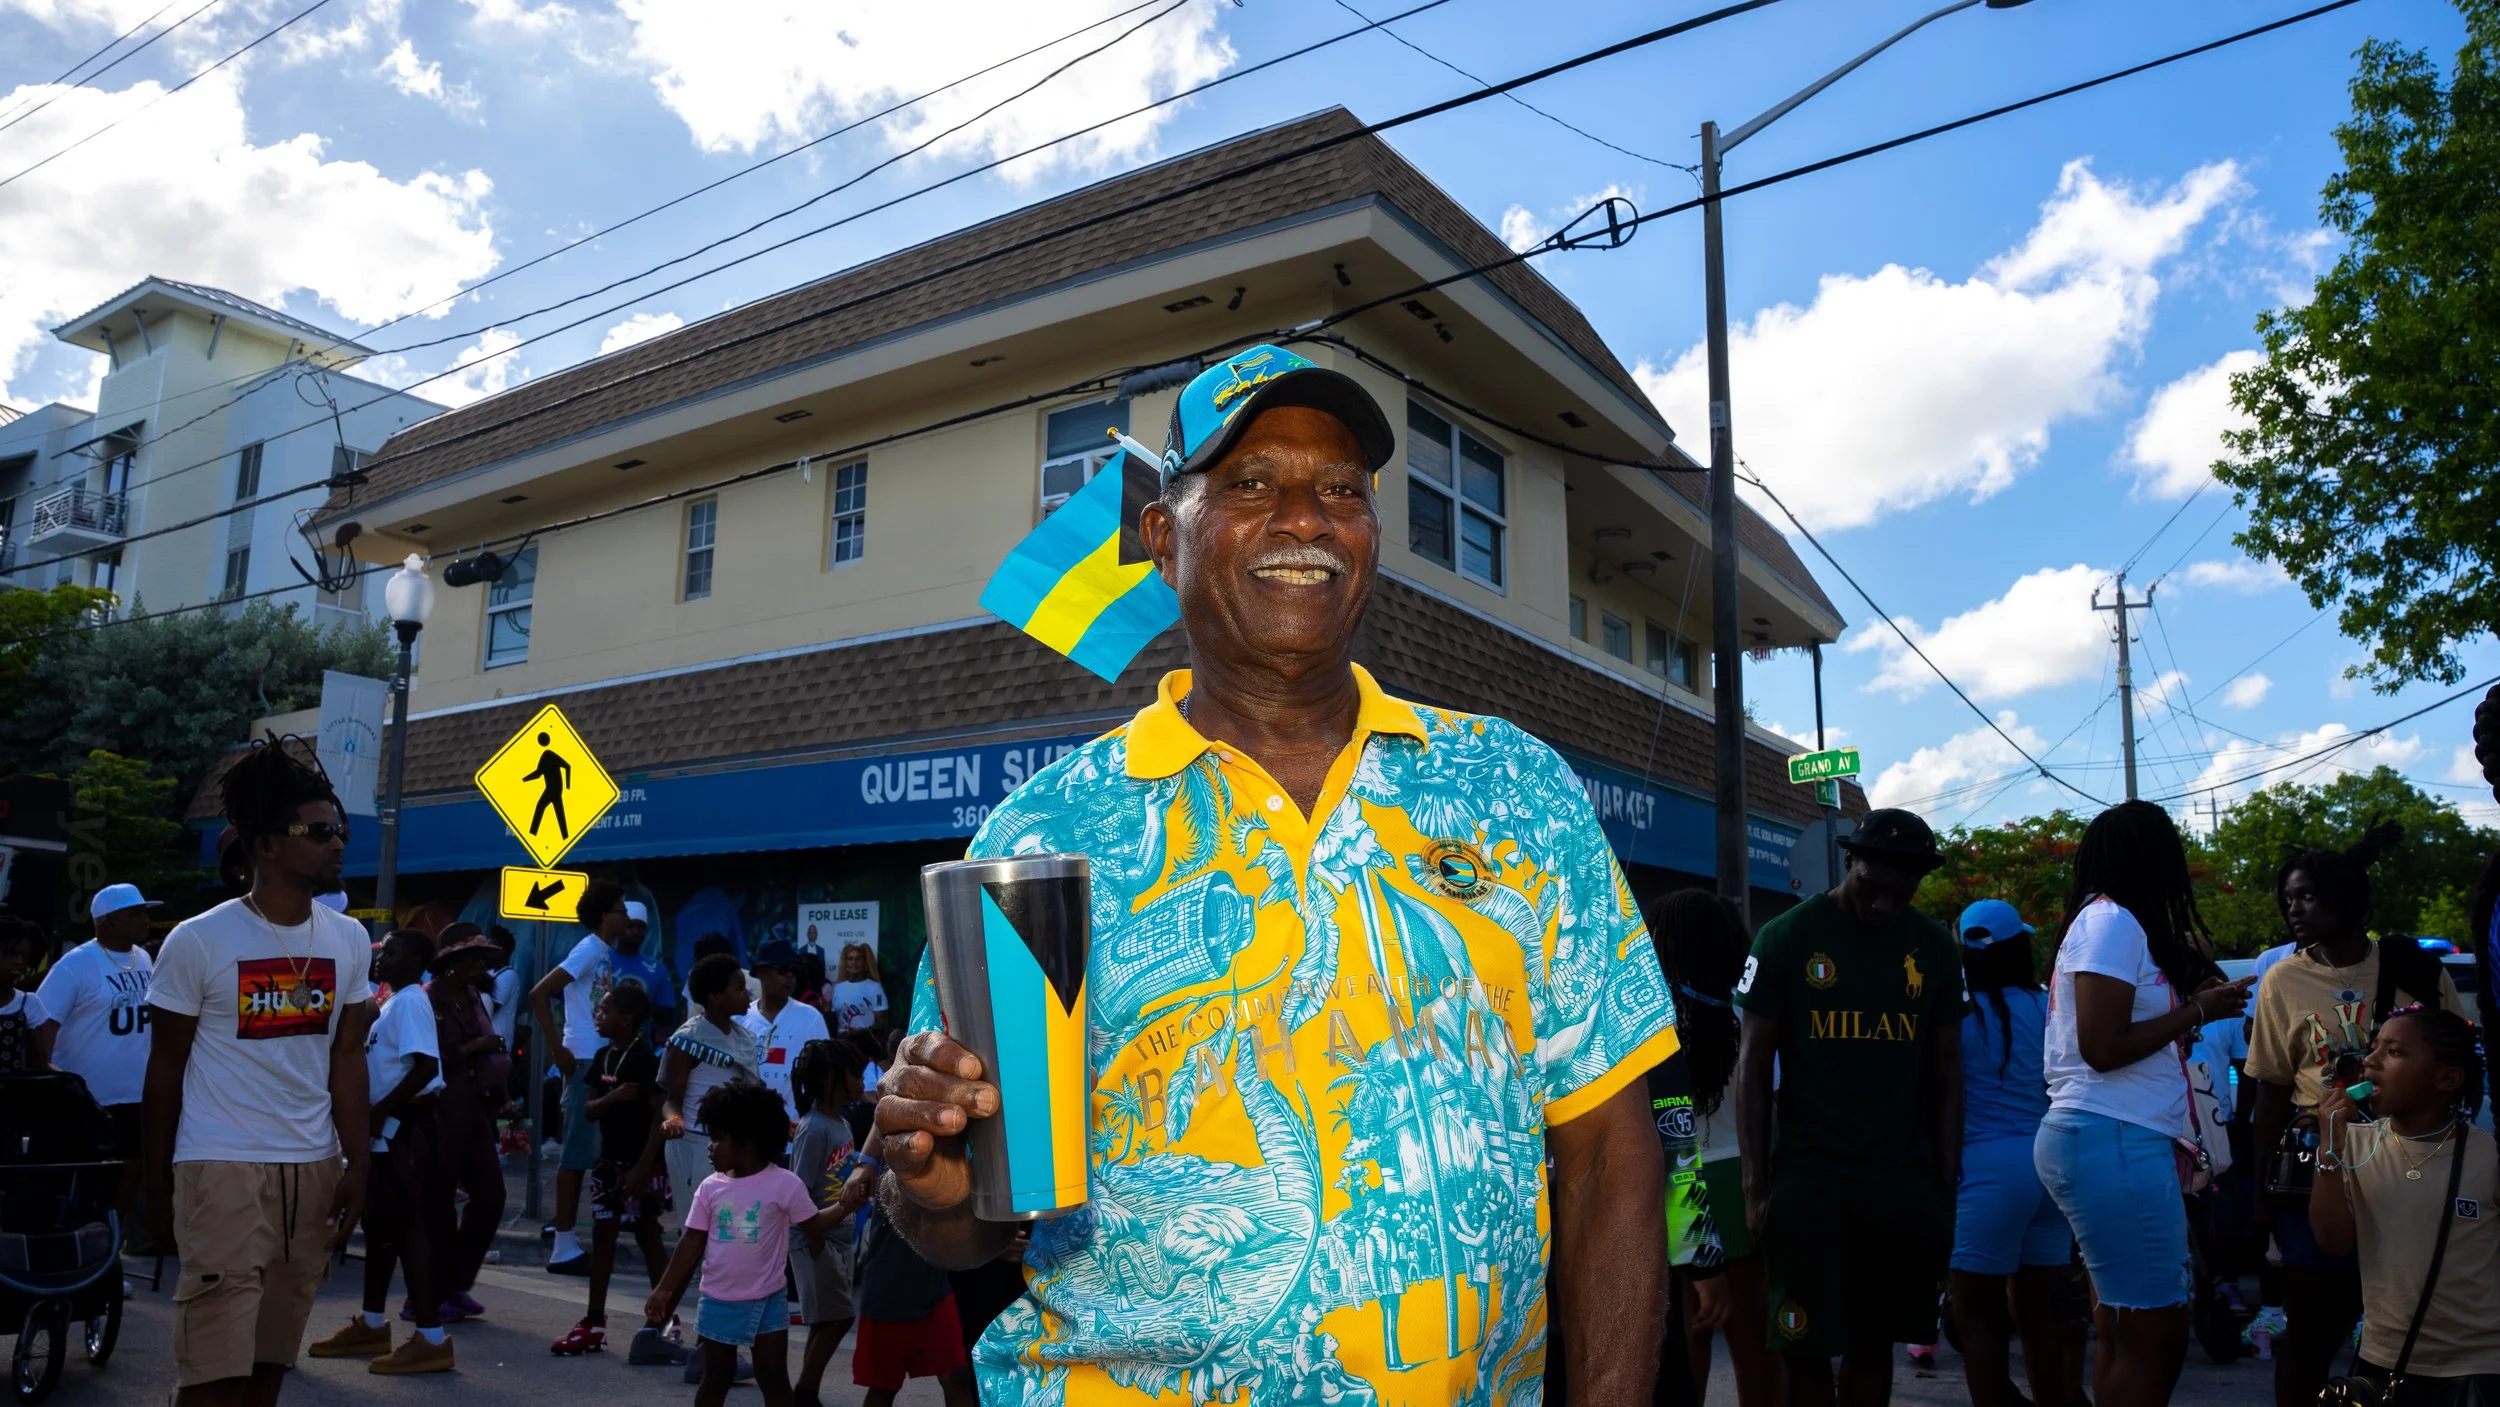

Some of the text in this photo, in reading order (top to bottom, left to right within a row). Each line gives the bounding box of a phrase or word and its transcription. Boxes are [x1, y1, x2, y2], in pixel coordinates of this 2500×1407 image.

[860, 753, 981, 805] QUEEN
[1797, 756, 1851, 777] GRAND AV
[616, 788, 647, 803] ED FPL
[1583, 777, 1656, 830] MARKET
[592, 813, 642, 830] ENT & ATM
[951, 803, 991, 829] 360
[1438, 882, 1488, 901] BAHAMAS
[808, 908, 868, 922] FOR LEASE
[1736, 954, 1759, 995] 3
[251, 988, 325, 1012] HUO
[109, 1005, 153, 1036] UP
[1130, 971, 1516, 1061] THE COMMONWEALTH OF THE
[1808, 1009, 1919, 1042] MILAN
[1135, 1004, 1526, 1132] BAHAMAS
[1675, 1112, 1692, 1133] 95
